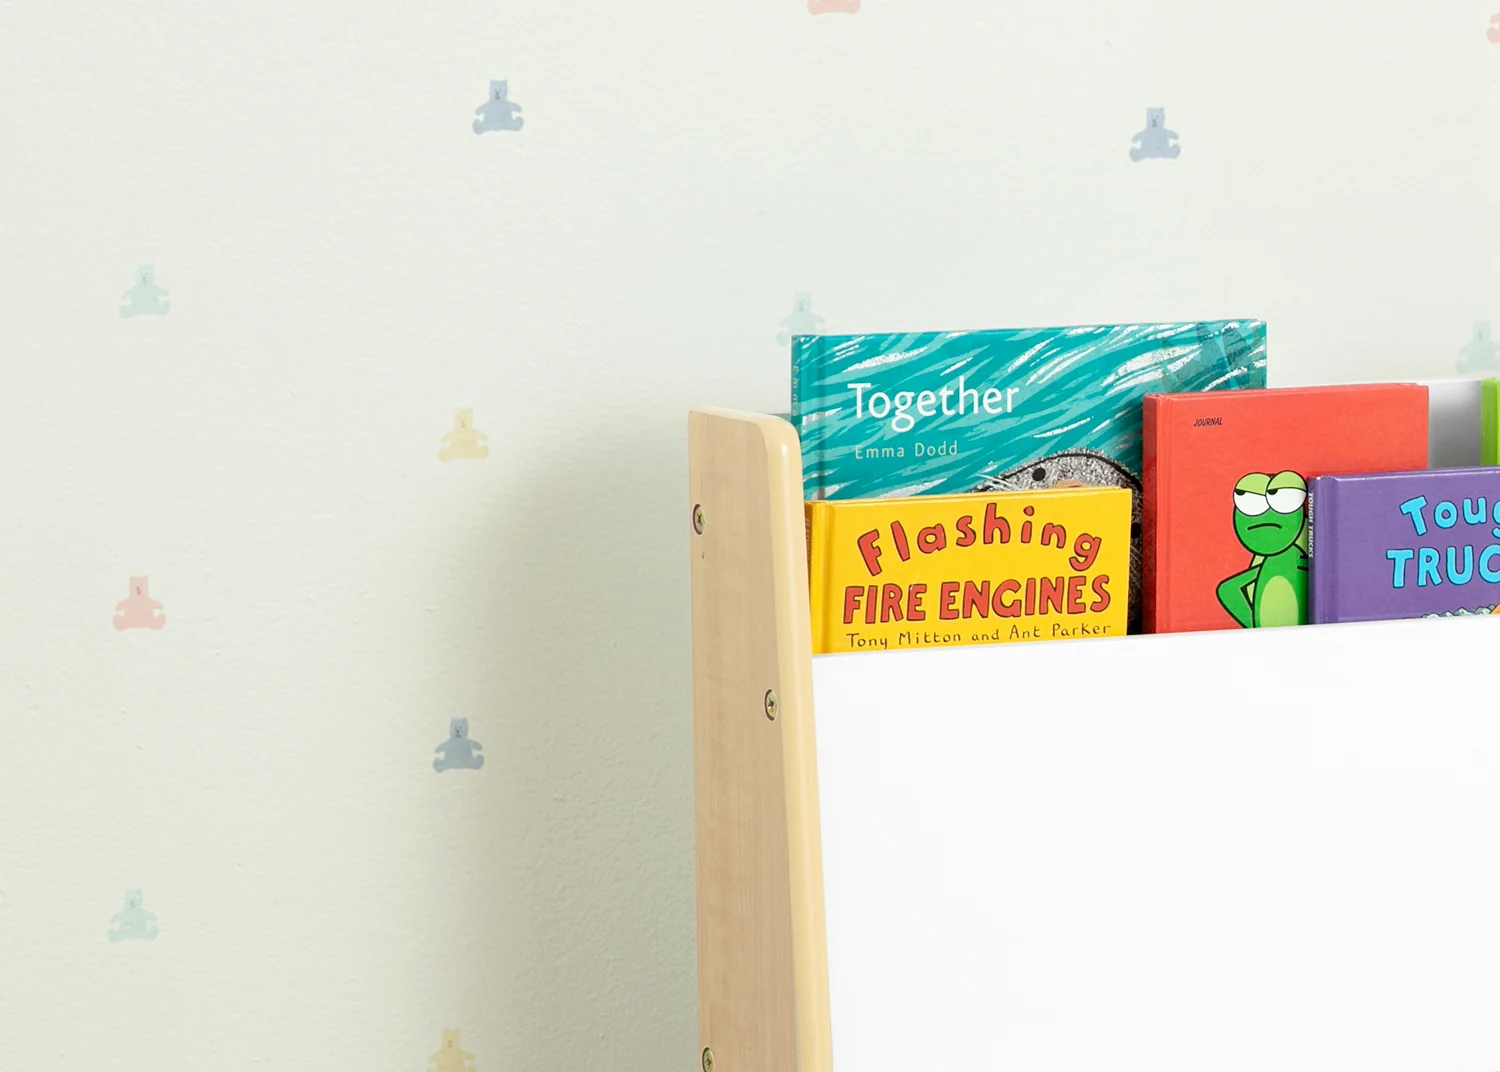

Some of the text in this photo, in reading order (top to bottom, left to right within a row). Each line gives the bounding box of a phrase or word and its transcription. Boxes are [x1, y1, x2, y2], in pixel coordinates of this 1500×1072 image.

[847, 376, 1020, 433] Together
[1193, 416, 1224, 428] JOURNAL
[855, 439, 959, 461] Emma Dodd
[856, 502, 1103, 577] Flashing
[843, 574, 1112, 625] FIRE ENGINES
[846, 621, 1112, 650] Tony Mitton and Ant Parker
